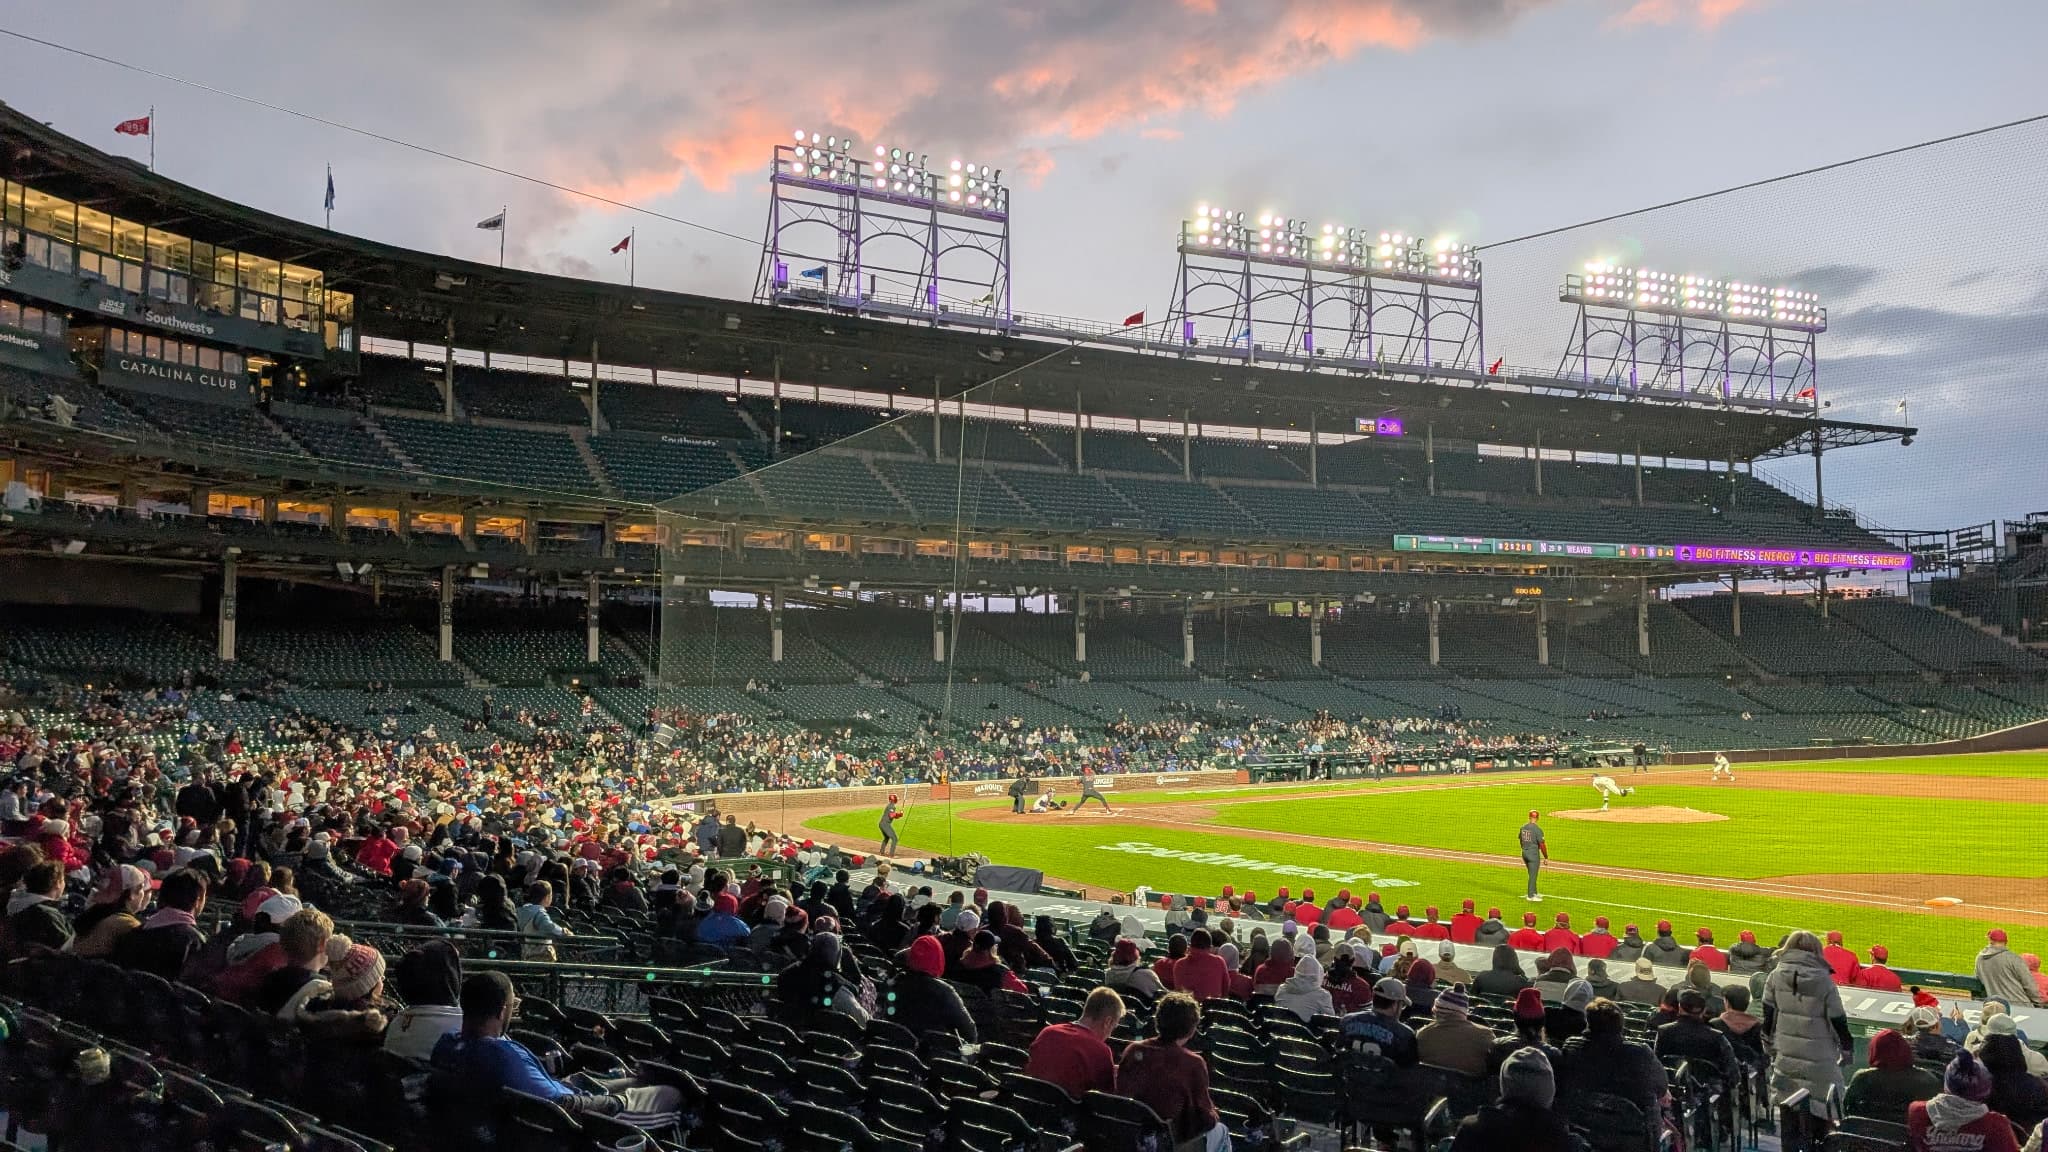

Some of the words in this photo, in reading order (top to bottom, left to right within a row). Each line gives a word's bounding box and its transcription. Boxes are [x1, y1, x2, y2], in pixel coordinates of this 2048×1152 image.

[145, 310, 207, 334] Southwest
[120, 359, 193, 384] CATALINA
[199, 374, 238, 390] CLUB
[1566, 544, 1593, 555] WEAVER
[1695, 548, 1713, 560] BIG
[1715, 549, 1756, 561] FITNESS
[1758, 550, 1797, 563] ENERGY
[1814, 552, 1830, 563] BIG
[1832, 553, 1870, 565] FITNESS
[1871, 554, 1908, 567] ENERGY
[974, 784, 1004, 794] MARQUEE
[1095, 841, 1381, 884] Southwest
